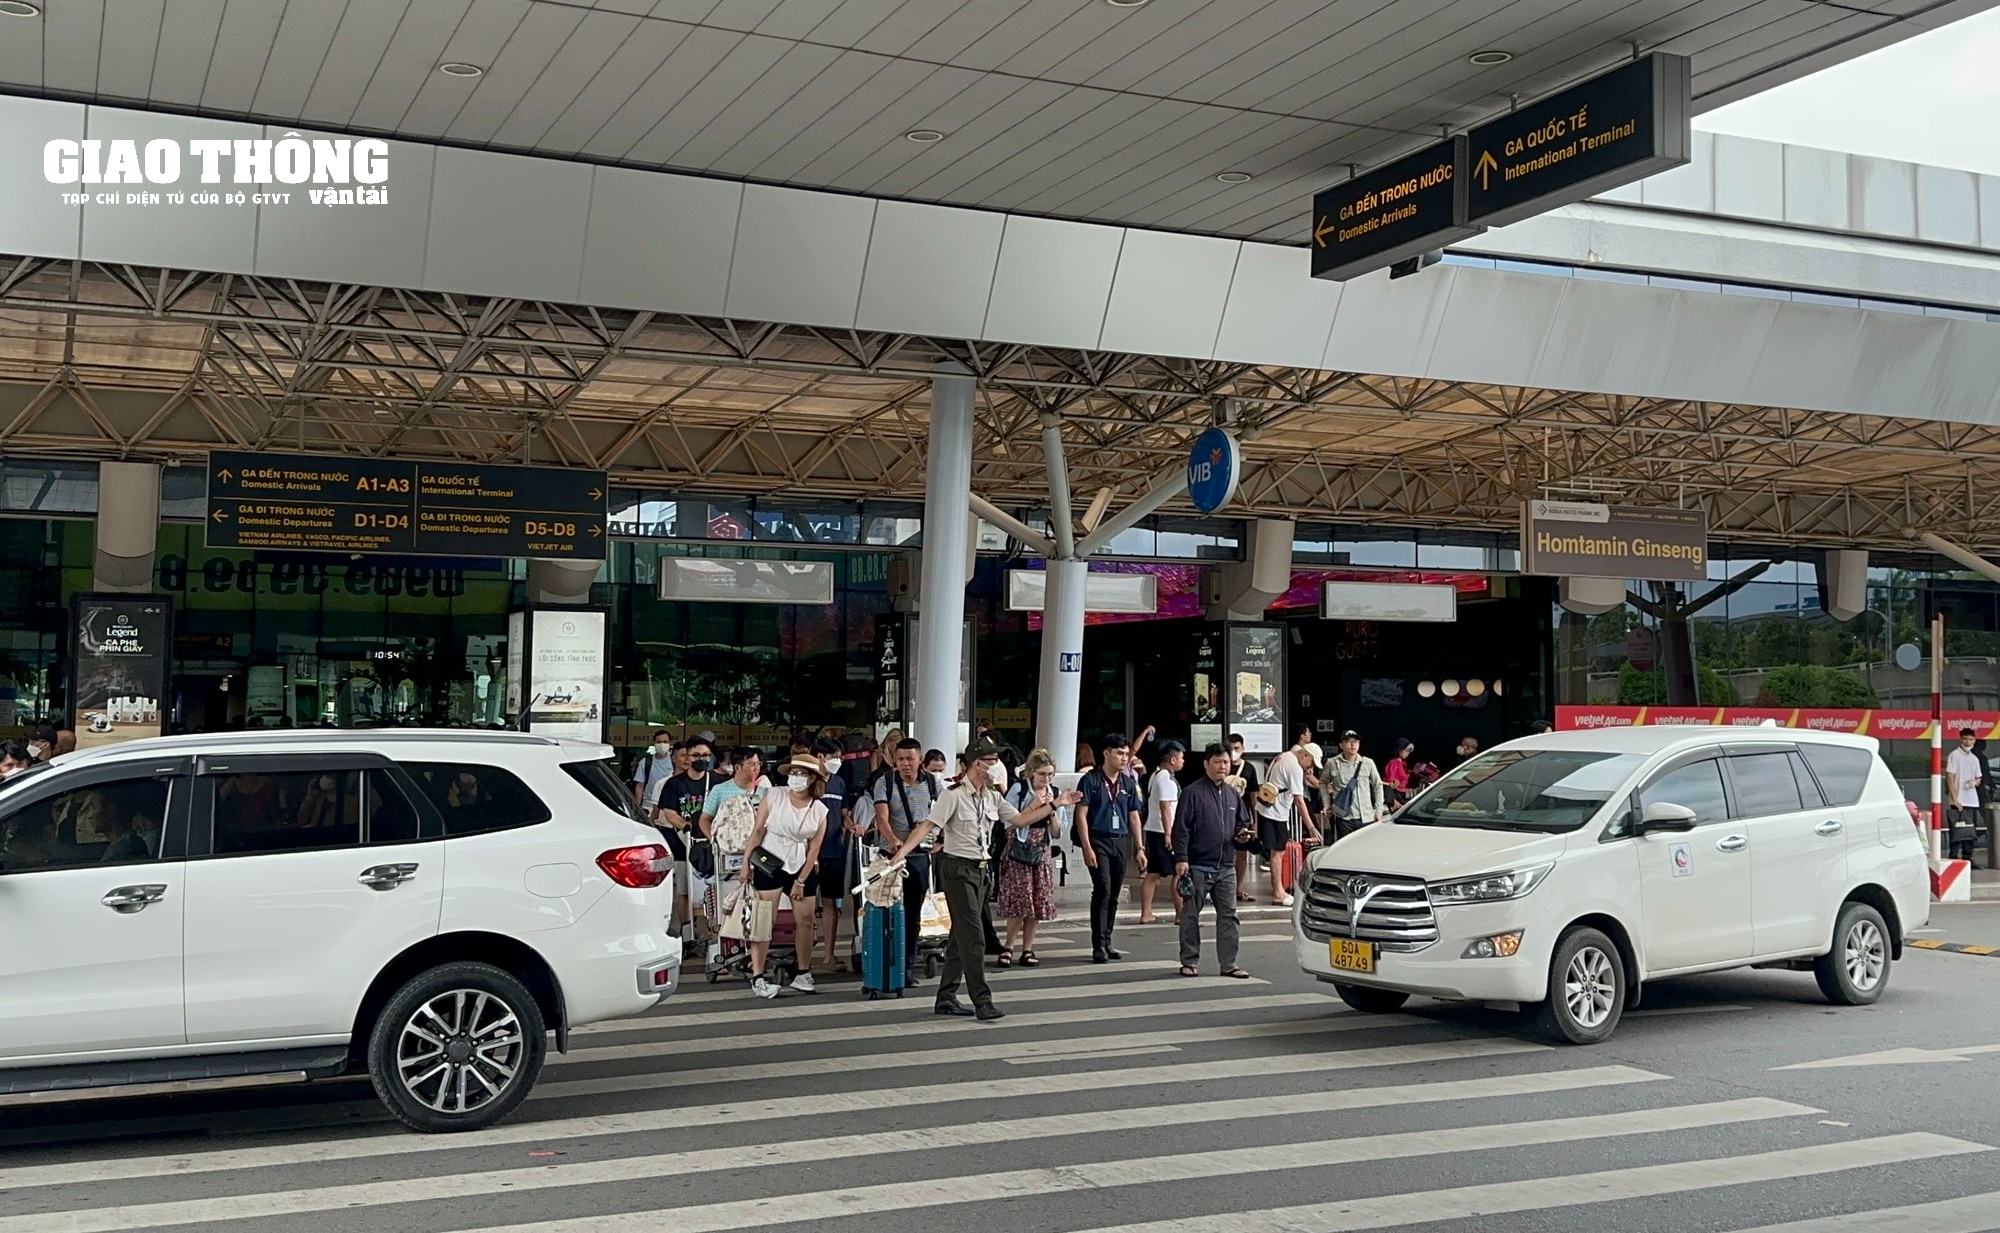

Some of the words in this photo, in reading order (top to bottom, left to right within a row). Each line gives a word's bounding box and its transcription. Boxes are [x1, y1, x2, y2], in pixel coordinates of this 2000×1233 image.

[1505, 137, 1524, 157] GA
[1527, 116, 1566, 148] QUỐC
[1569, 104, 1588, 131] TẾ
[1505, 141, 1577, 181] International
[1579, 118, 1635, 152] Terminal
[1339, 204, 1354, 221] GA
[1356, 191, 1378, 215] ĐẾN
[1380, 178, 1417, 205] TRONG
[1420, 163, 1453, 190] NƯỚC
[1339, 217, 1380, 242] Domestic
[1381, 203, 1417, 227] Arrivals
[241, 468, 257, 478] GA
[283, 471, 319, 481] TRONG
[321, 471, 349, 482] NƯỚC
[421, 476, 435, 484] GA
[437, 474, 466, 486] QUỐC
[467, 475, 480, 486] TẾ
[1189, 462, 1211, 485] VIB
[241, 480, 284, 490] Domestic
[286, 482, 321, 491] Arrivals
[356, 476, 410, 493] A1-A3
[421, 486, 475, 496] International
[477, 488, 514, 498] Terminal
[238, 505, 254, 513] GA
[256, 506, 267, 514] ĐI
[269, 506, 304, 516] TRONG
[307, 507, 336, 517] NƯỚC
[421, 513, 435, 521] GA
[437, 513, 447, 521] ĐI
[448, 514, 482, 522] TRONG
[238, 516, 281, 526] Domestic
[283, 518, 333, 528] Departures
[354, 513, 409, 529] D1-D4
[420, 523, 461, 533] Domestic
[462, 525, 509, 535] Departures
[525, 521, 576, 537] D5-D8
[527, 542, 559, 551] VIETJET
[560, 543, 573, 551] AIR
[1537, 531, 1628, 557] Homtamin
[1631, 537, 1703, 565] Ginseng
[106, 626, 138, 638] Legend
[374, 650, 400, 659] 10:54
[1341, 940, 1360, 955] 60A
